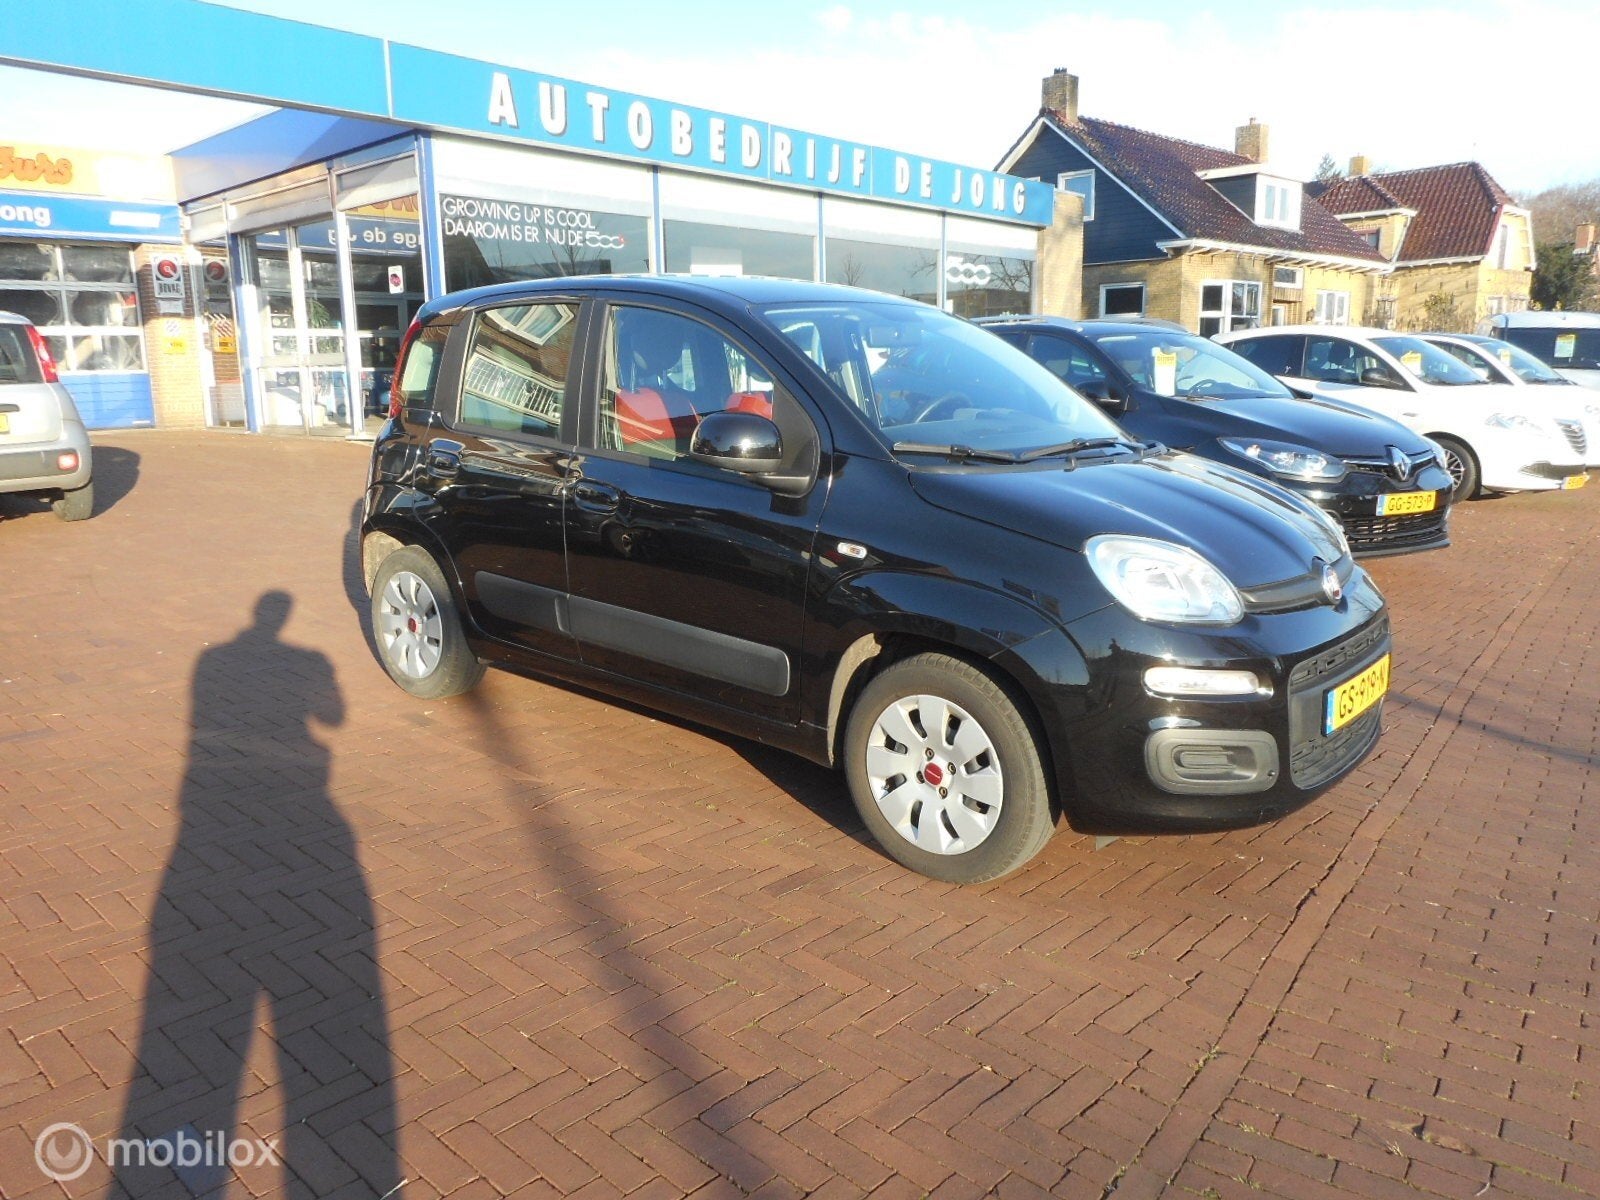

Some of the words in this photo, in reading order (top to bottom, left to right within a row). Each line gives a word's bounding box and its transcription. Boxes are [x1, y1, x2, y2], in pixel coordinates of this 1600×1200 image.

[487, 71, 867, 188] AUTOBEDRIJF
[895, 156, 932, 199] DE
[952, 169, 1025, 215] JONG
[443, 197, 521, 222] GROWING
[524, 205, 541, 224] UP
[544, 208, 555, 225] IS
[557, 210, 596, 229] COOL
[444, 218, 510, 241] DAAROM
[511, 224, 522, 241] IS
[524, 226, 540, 243] ER
[545, 228, 565, 246] NU
[568, 231, 583, 246] DE
[946, 256, 991, 285] 500
